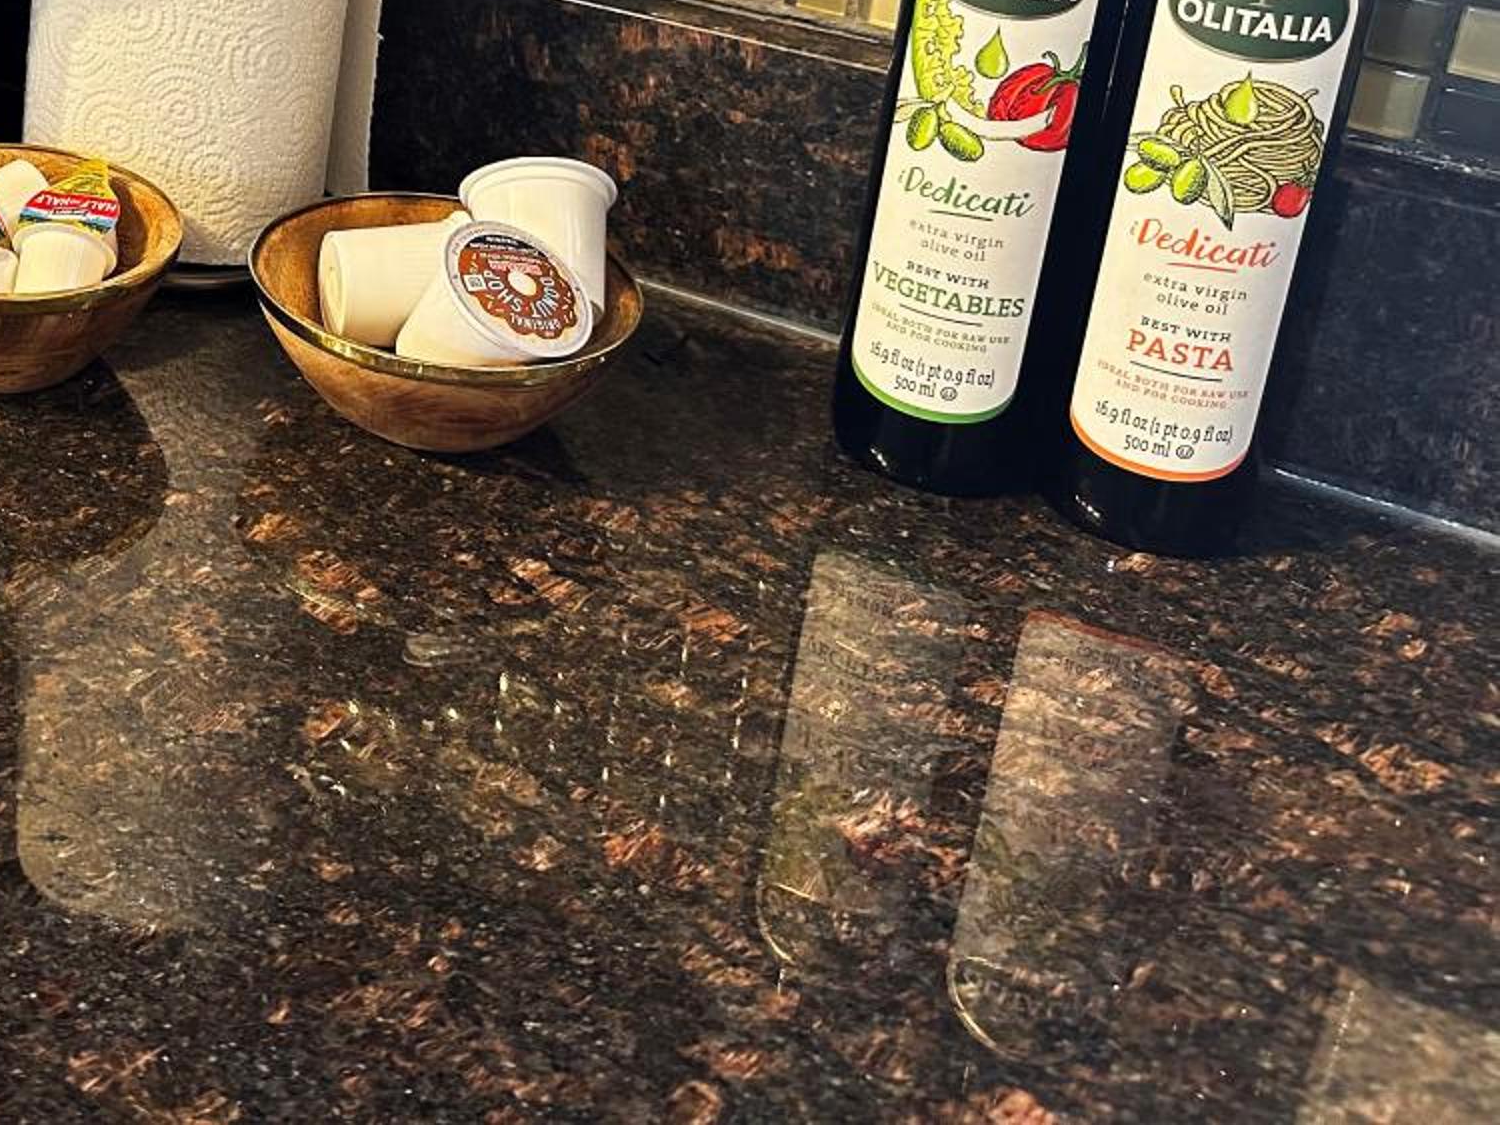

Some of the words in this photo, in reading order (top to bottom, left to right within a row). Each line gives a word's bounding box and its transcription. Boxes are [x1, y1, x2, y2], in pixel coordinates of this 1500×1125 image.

[909, 219, 948, 239] extra
[955, 232, 1004, 250] virgin
[921, 238, 959, 257] olive
[964, 250, 985, 262] oil
[873, 261, 1025, 318] VEGETABLES
[906, 260, 941, 280] BEST
[946, 273, 990, 290] WITH
[1143, 272, 1188, 293] extra
[1194, 284, 1248, 302] virgin
[483, 270, 523, 313] SHOP
[531, 276, 560, 318] DONUT
[1156, 292, 1199, 312] olive
[1205, 303, 1229, 316] oil
[910, 330, 932, 345] FOR
[934, 338, 987, 354] COOKING
[936, 327, 959, 341] FOR
[1140, 315, 1181, 335] BEST
[1186, 328, 1232, 343] WITH
[1125, 328, 1234, 372] PASTA
[894, 374, 917, 392] 500
[918, 382, 936, 398] ml
[901, 356, 915, 372] oz
[926, 364, 941, 382] pt
[943, 368, 963, 386] 0.9
[965, 368, 976, 386] fl
[977, 369, 995, 390] oz)
[1135, 374, 1170, 392] BOTH
[1173, 385, 1198, 397] FOR
[1201, 388, 1227, 399] RAW
[1116, 379, 1140, 393] AND
[1143, 386, 1168, 400] FOR
[1171, 394, 1228, 409] COOKING
[1095, 400, 1119, 424] 16.9
[1120, 408, 1131, 425] fl
[1132, 416, 1148, 432] oz
[1161, 422, 1179, 441] pt
[1180, 426, 1201, 445] 0.9
[1203, 424, 1215, 442] fl
[1215, 423, 1234, 447] oz)
[1124, 434, 1149, 452] 500
[1151, 440, 1171, 458] ml
